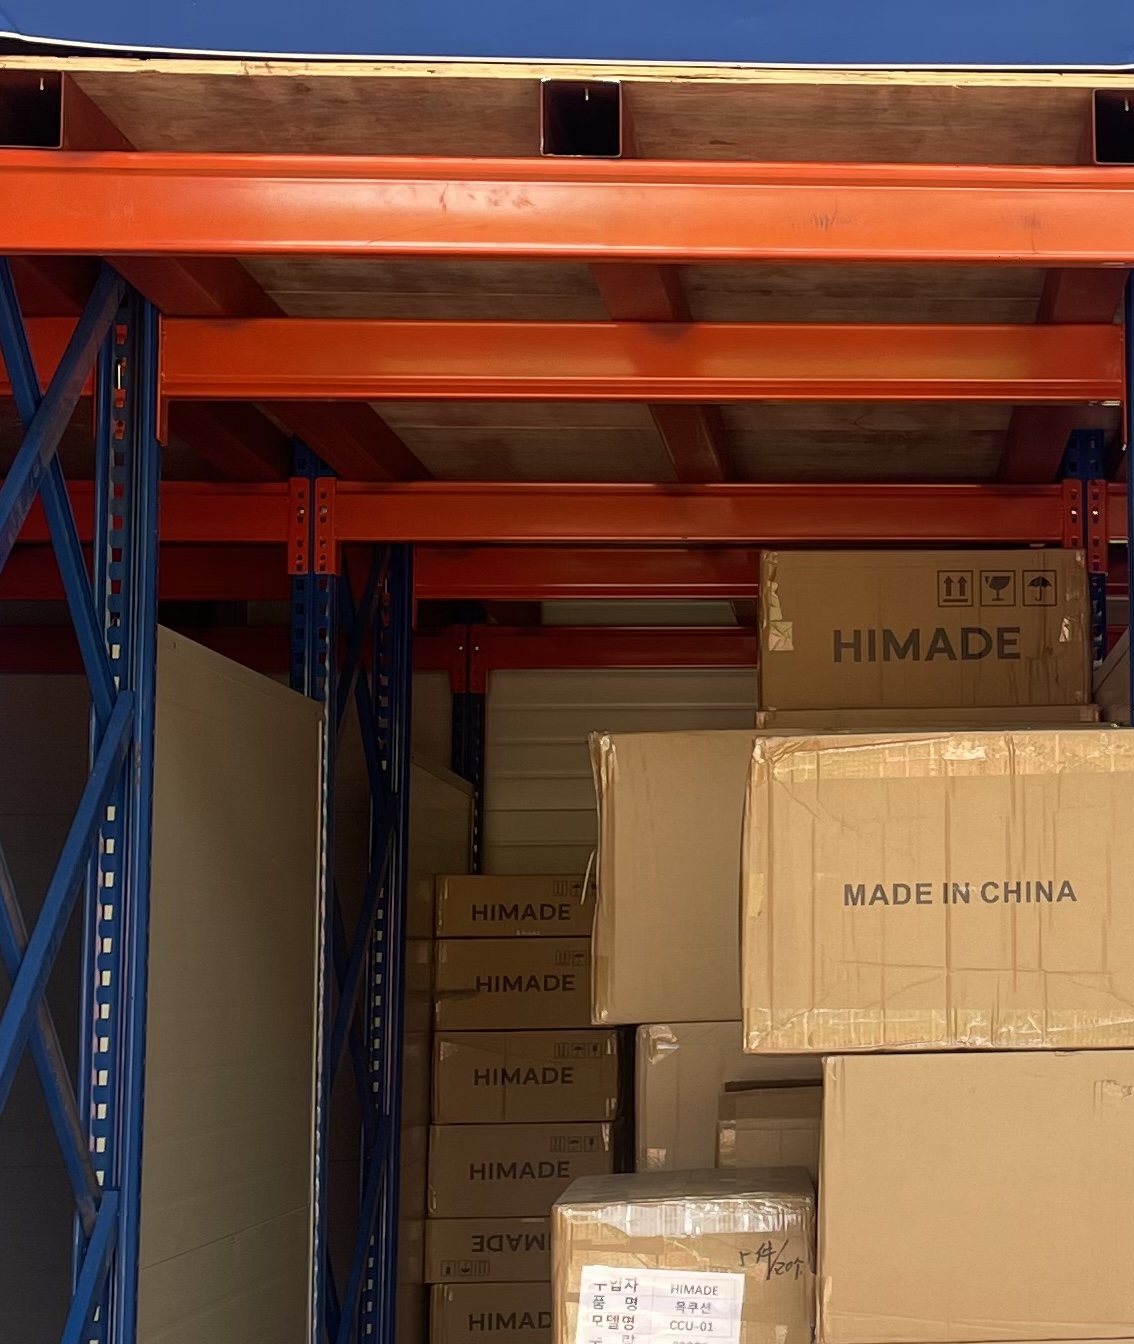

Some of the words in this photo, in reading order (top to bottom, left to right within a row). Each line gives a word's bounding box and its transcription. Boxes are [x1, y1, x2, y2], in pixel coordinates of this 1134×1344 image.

[833, 626, 1021, 663] HIMADE
[843, 883, 933, 906] MADE
[942, 882, 971, 905] IN
[980, 879, 1078, 904] CHINA
[471, 903, 571, 921] HIMADE
[475, 974, 575, 993] HIMADE
[474, 1067, 574, 1086] HIMADE
[469, 1161, 571, 1181] HIMADE
[471, 1232, 552, 1253] IMADE
[670, 1284, 719, 1296] HIMADE
[468, 1311, 553, 1332] HIMAD
[592, 1314, 635, 1331] 모델명
[669, 1320, 714, 1332] CCU-01
